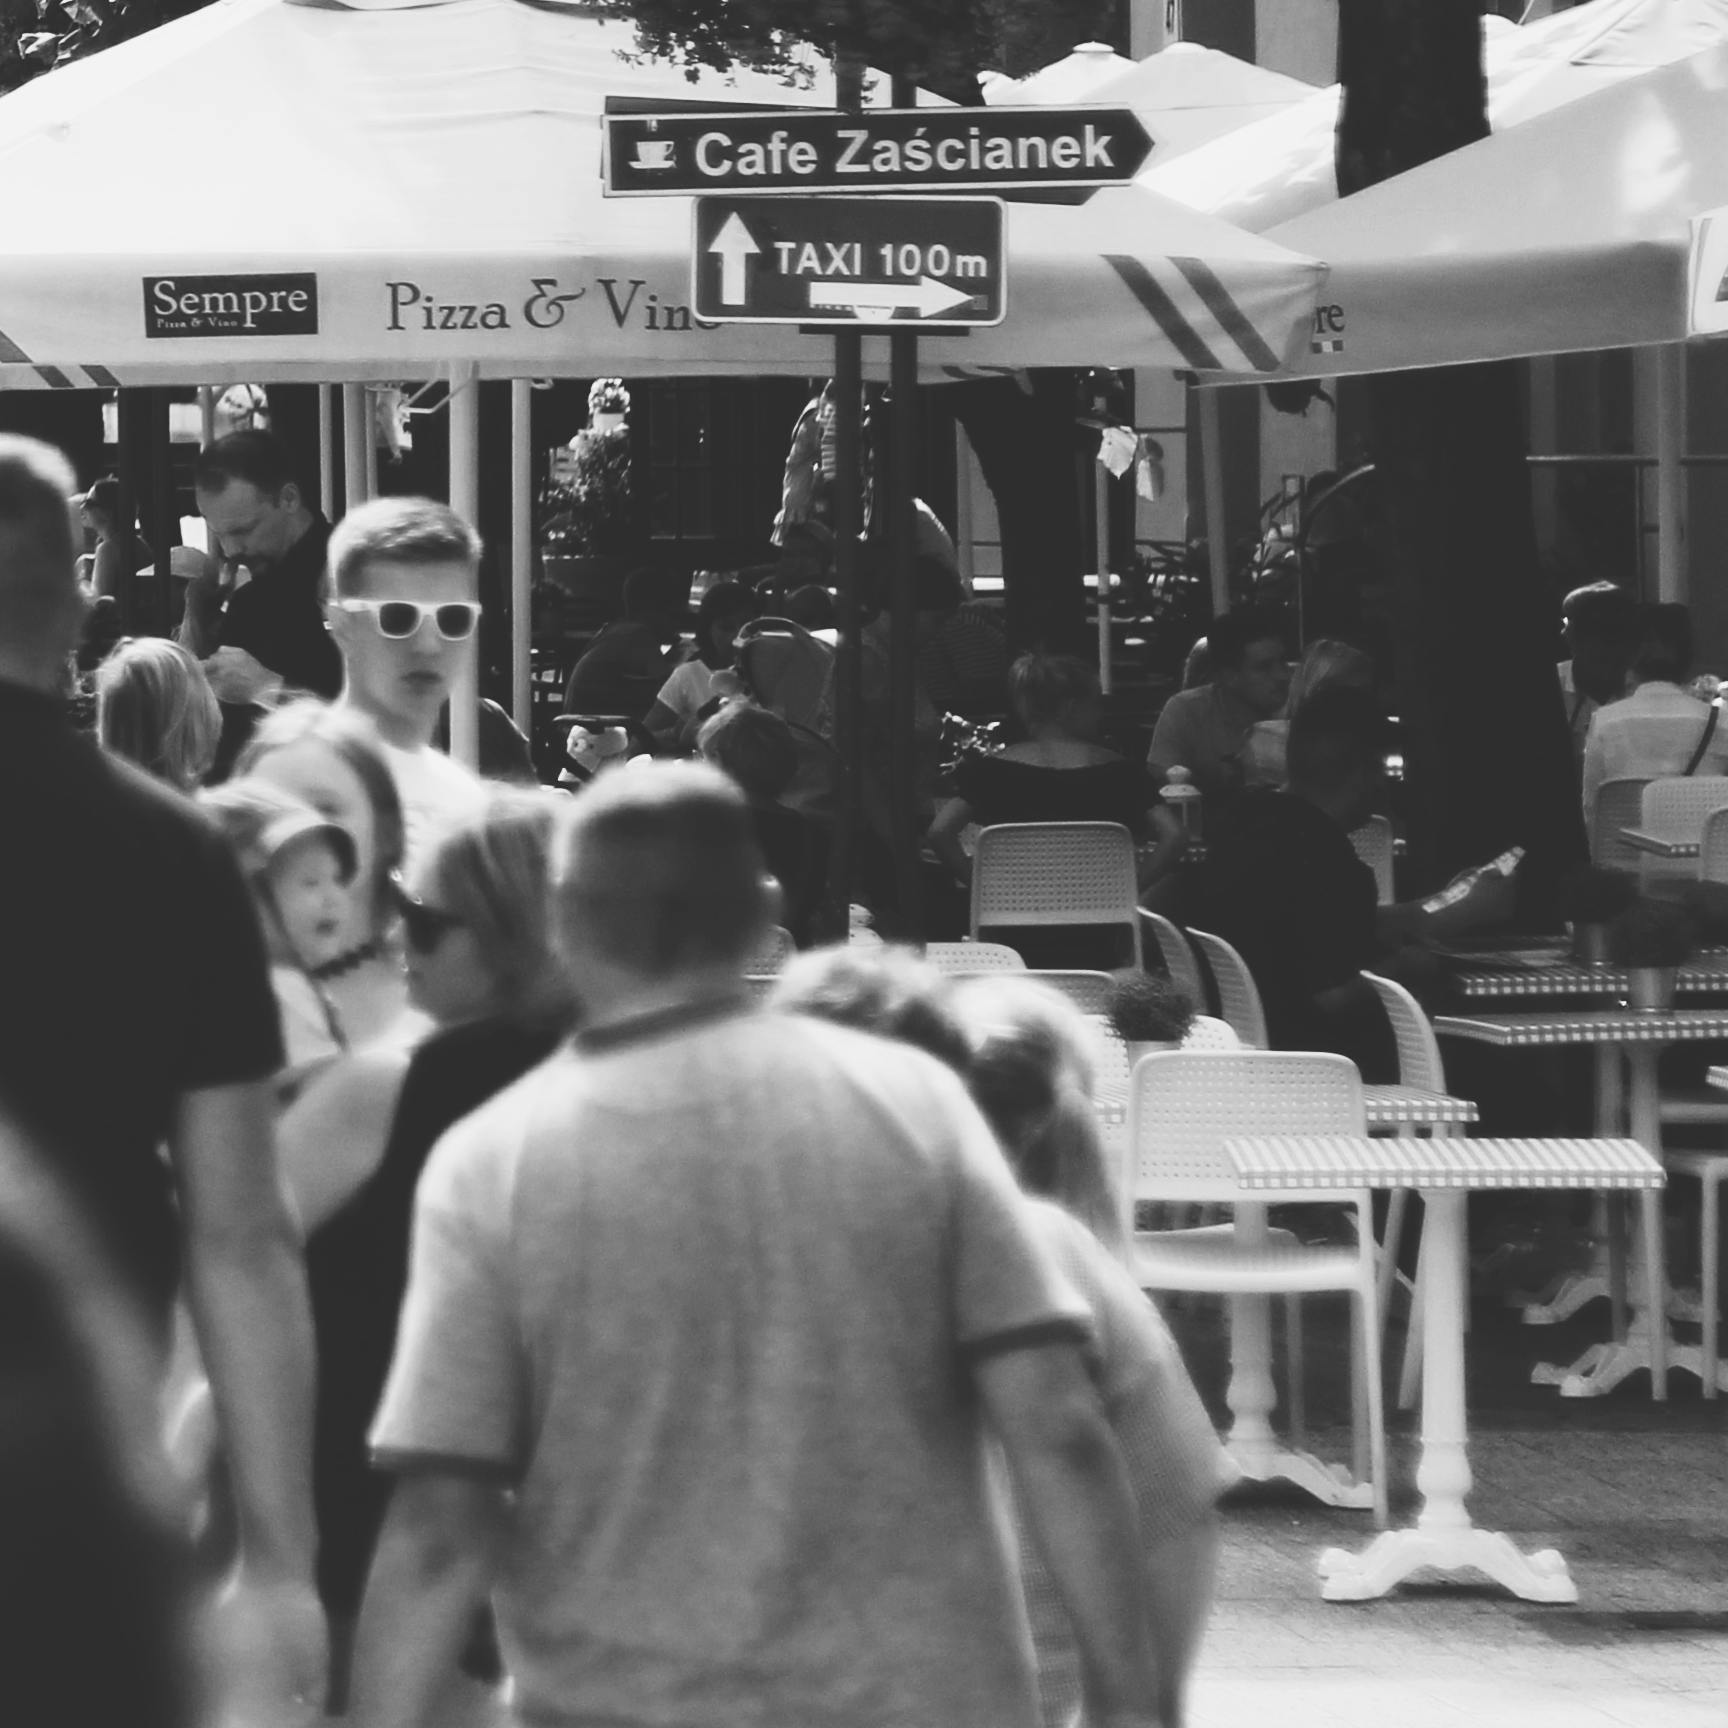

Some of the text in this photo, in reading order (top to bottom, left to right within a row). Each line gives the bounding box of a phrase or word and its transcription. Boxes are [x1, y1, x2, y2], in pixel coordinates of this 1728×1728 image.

[695, 124, 1114, 177] Cafe Zaścianek
[774, 241, 862, 276] TAXI
[153, 280, 308, 328] Sempre
[385, 278, 722, 331] Pizza & Vin
[1312, 305, 1345, 333] re
